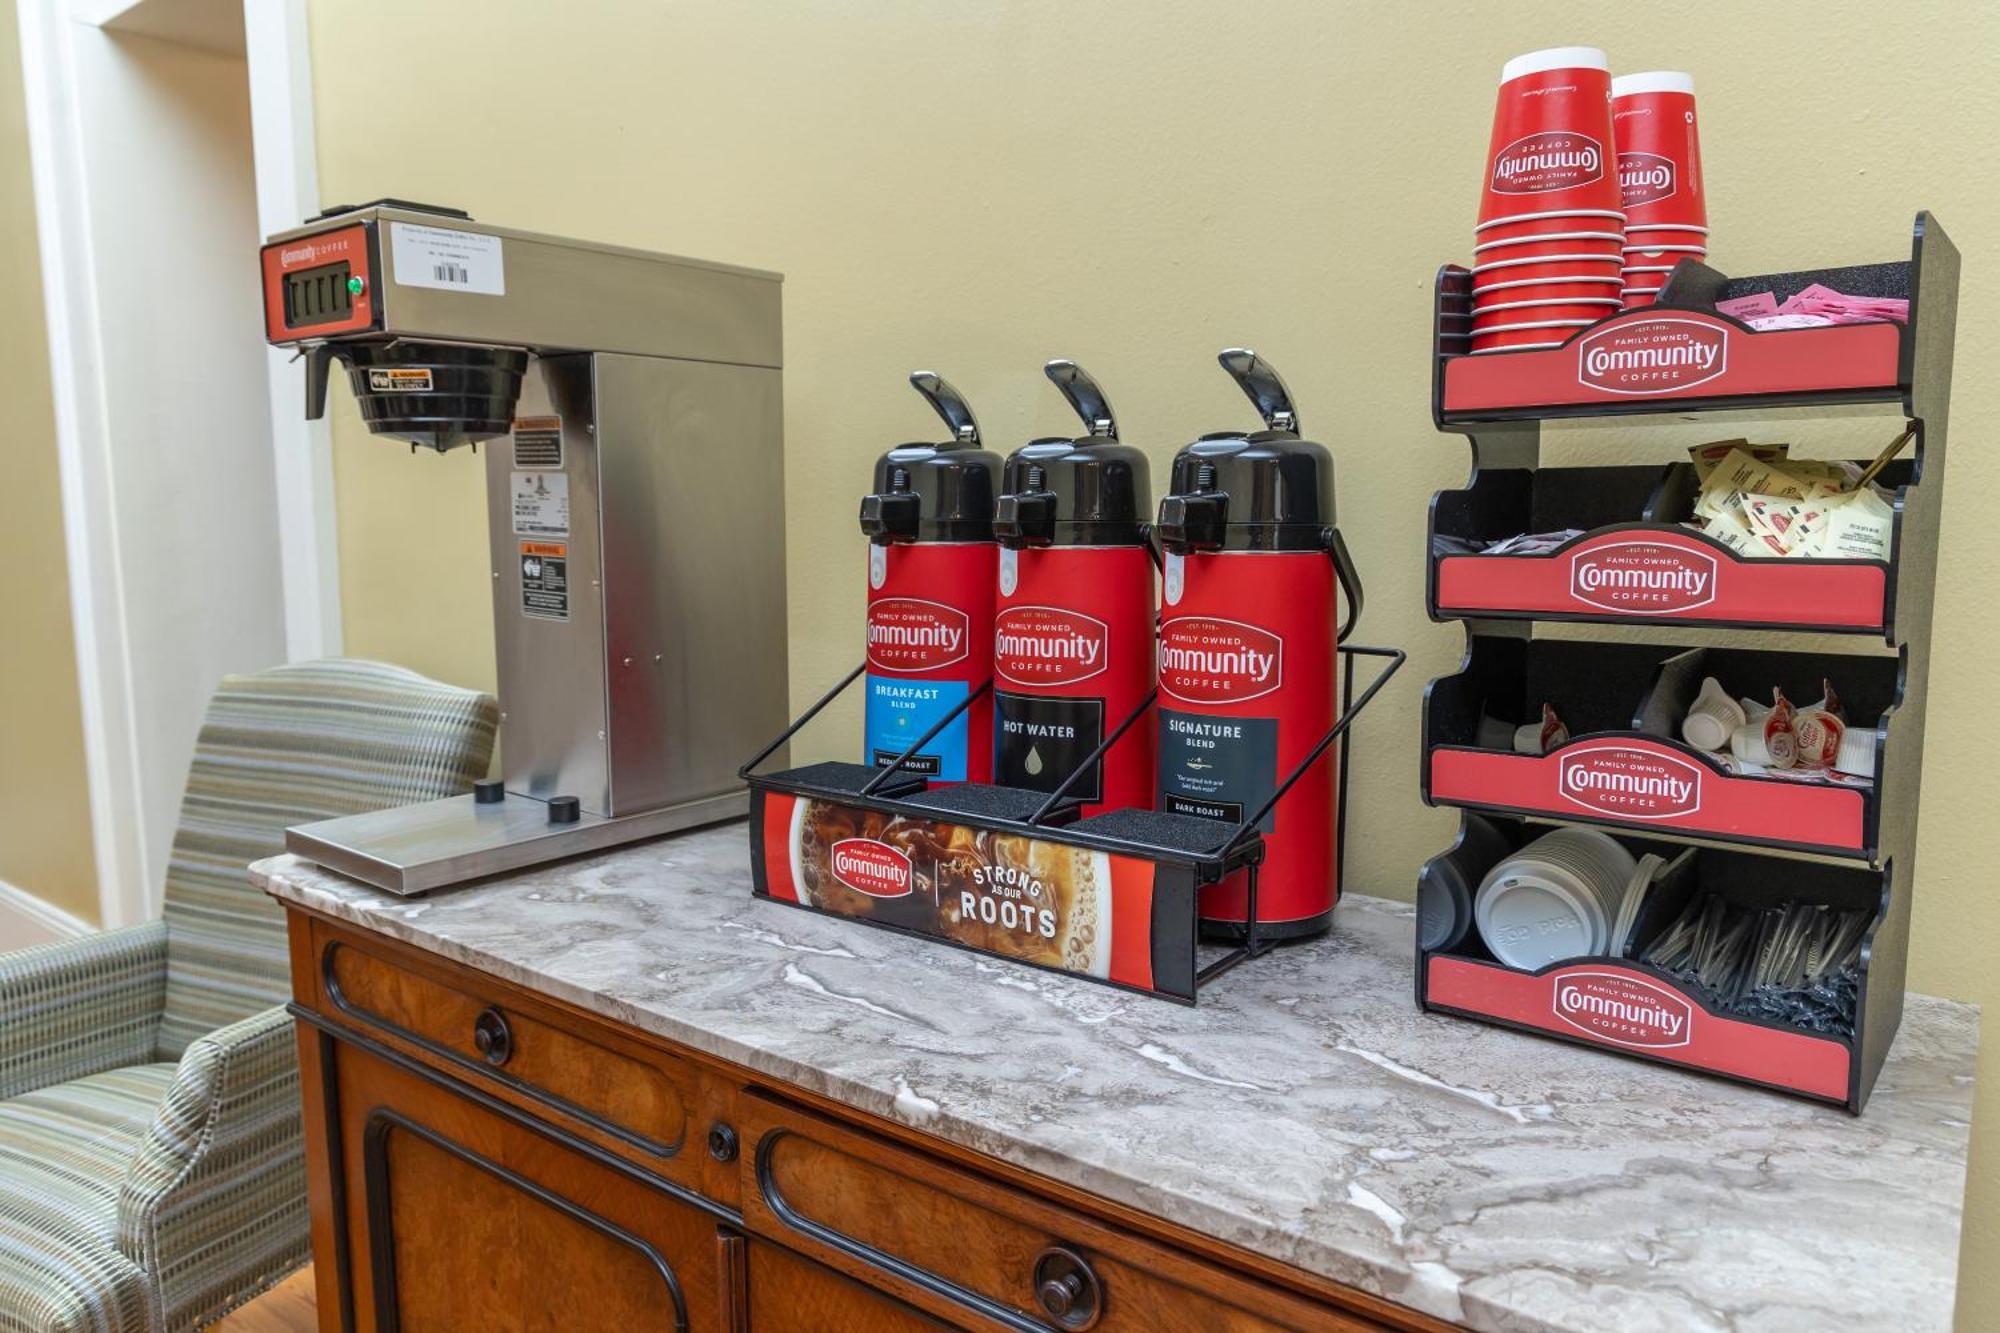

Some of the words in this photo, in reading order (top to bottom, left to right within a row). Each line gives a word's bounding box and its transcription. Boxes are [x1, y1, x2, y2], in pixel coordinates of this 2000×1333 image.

[1496, 146, 1598, 180] Community
[1615, 336, 1649, 346] FAMILY
[1652, 333, 1690, 343] OWNED
[1587, 340, 1719, 377] Community
[1620, 371, 1680, 382] COFFEE
[1606, 556, 1640, 564] FAMILY
[1579, 562, 1707, 596] Community
[1612, 592, 1670, 602] COFFEE
[902, 614, 935, 622] OWNED
[1035, 624, 1070, 632] OWNED
[1171, 634, 1199, 643] FAMILY
[1202, 636, 1241, 645] OWNED
[880, 650, 927, 660] COFFEE
[1160, 640, 1273, 682] Community
[1011, 662, 1063, 673] COFFEE
[1175, 676, 1231, 690] COFFEE
[875, 684, 939, 699] BREAKFAST
[891, 700, 916, 709] BLEND
[1003, 720, 1023, 734] HOT
[1026, 724, 1075, 738] WATER
[1169, 719, 1241, 738] SIGNATURE
[1186, 738, 1215, 749] BLEND
[905, 761, 930, 769] ROAST
[1594, 759, 1626, 769] FAMILY
[1629, 764, 1665, 774] OWNED
[1567, 764, 1693, 804] Community
[1600, 794, 1656, 808] COFFEE
[1175, 802, 1194, 813] DARK
[1196, 806, 1224, 817] ROAST
[836, 851, 907, 887] Community
[973, 866, 1042, 897] STRONG
[992, 884, 1002, 895] AS
[1004, 887, 1022, 900] OUR
[961, 891, 1056, 938] ROOTS
[1587, 983, 1619, 995] FAMILY
[1622, 992, 1656, 1005] OWNED
[1561, 985, 1683, 1036] Community
[1592, 1018, 1648, 1037] COFFEE
